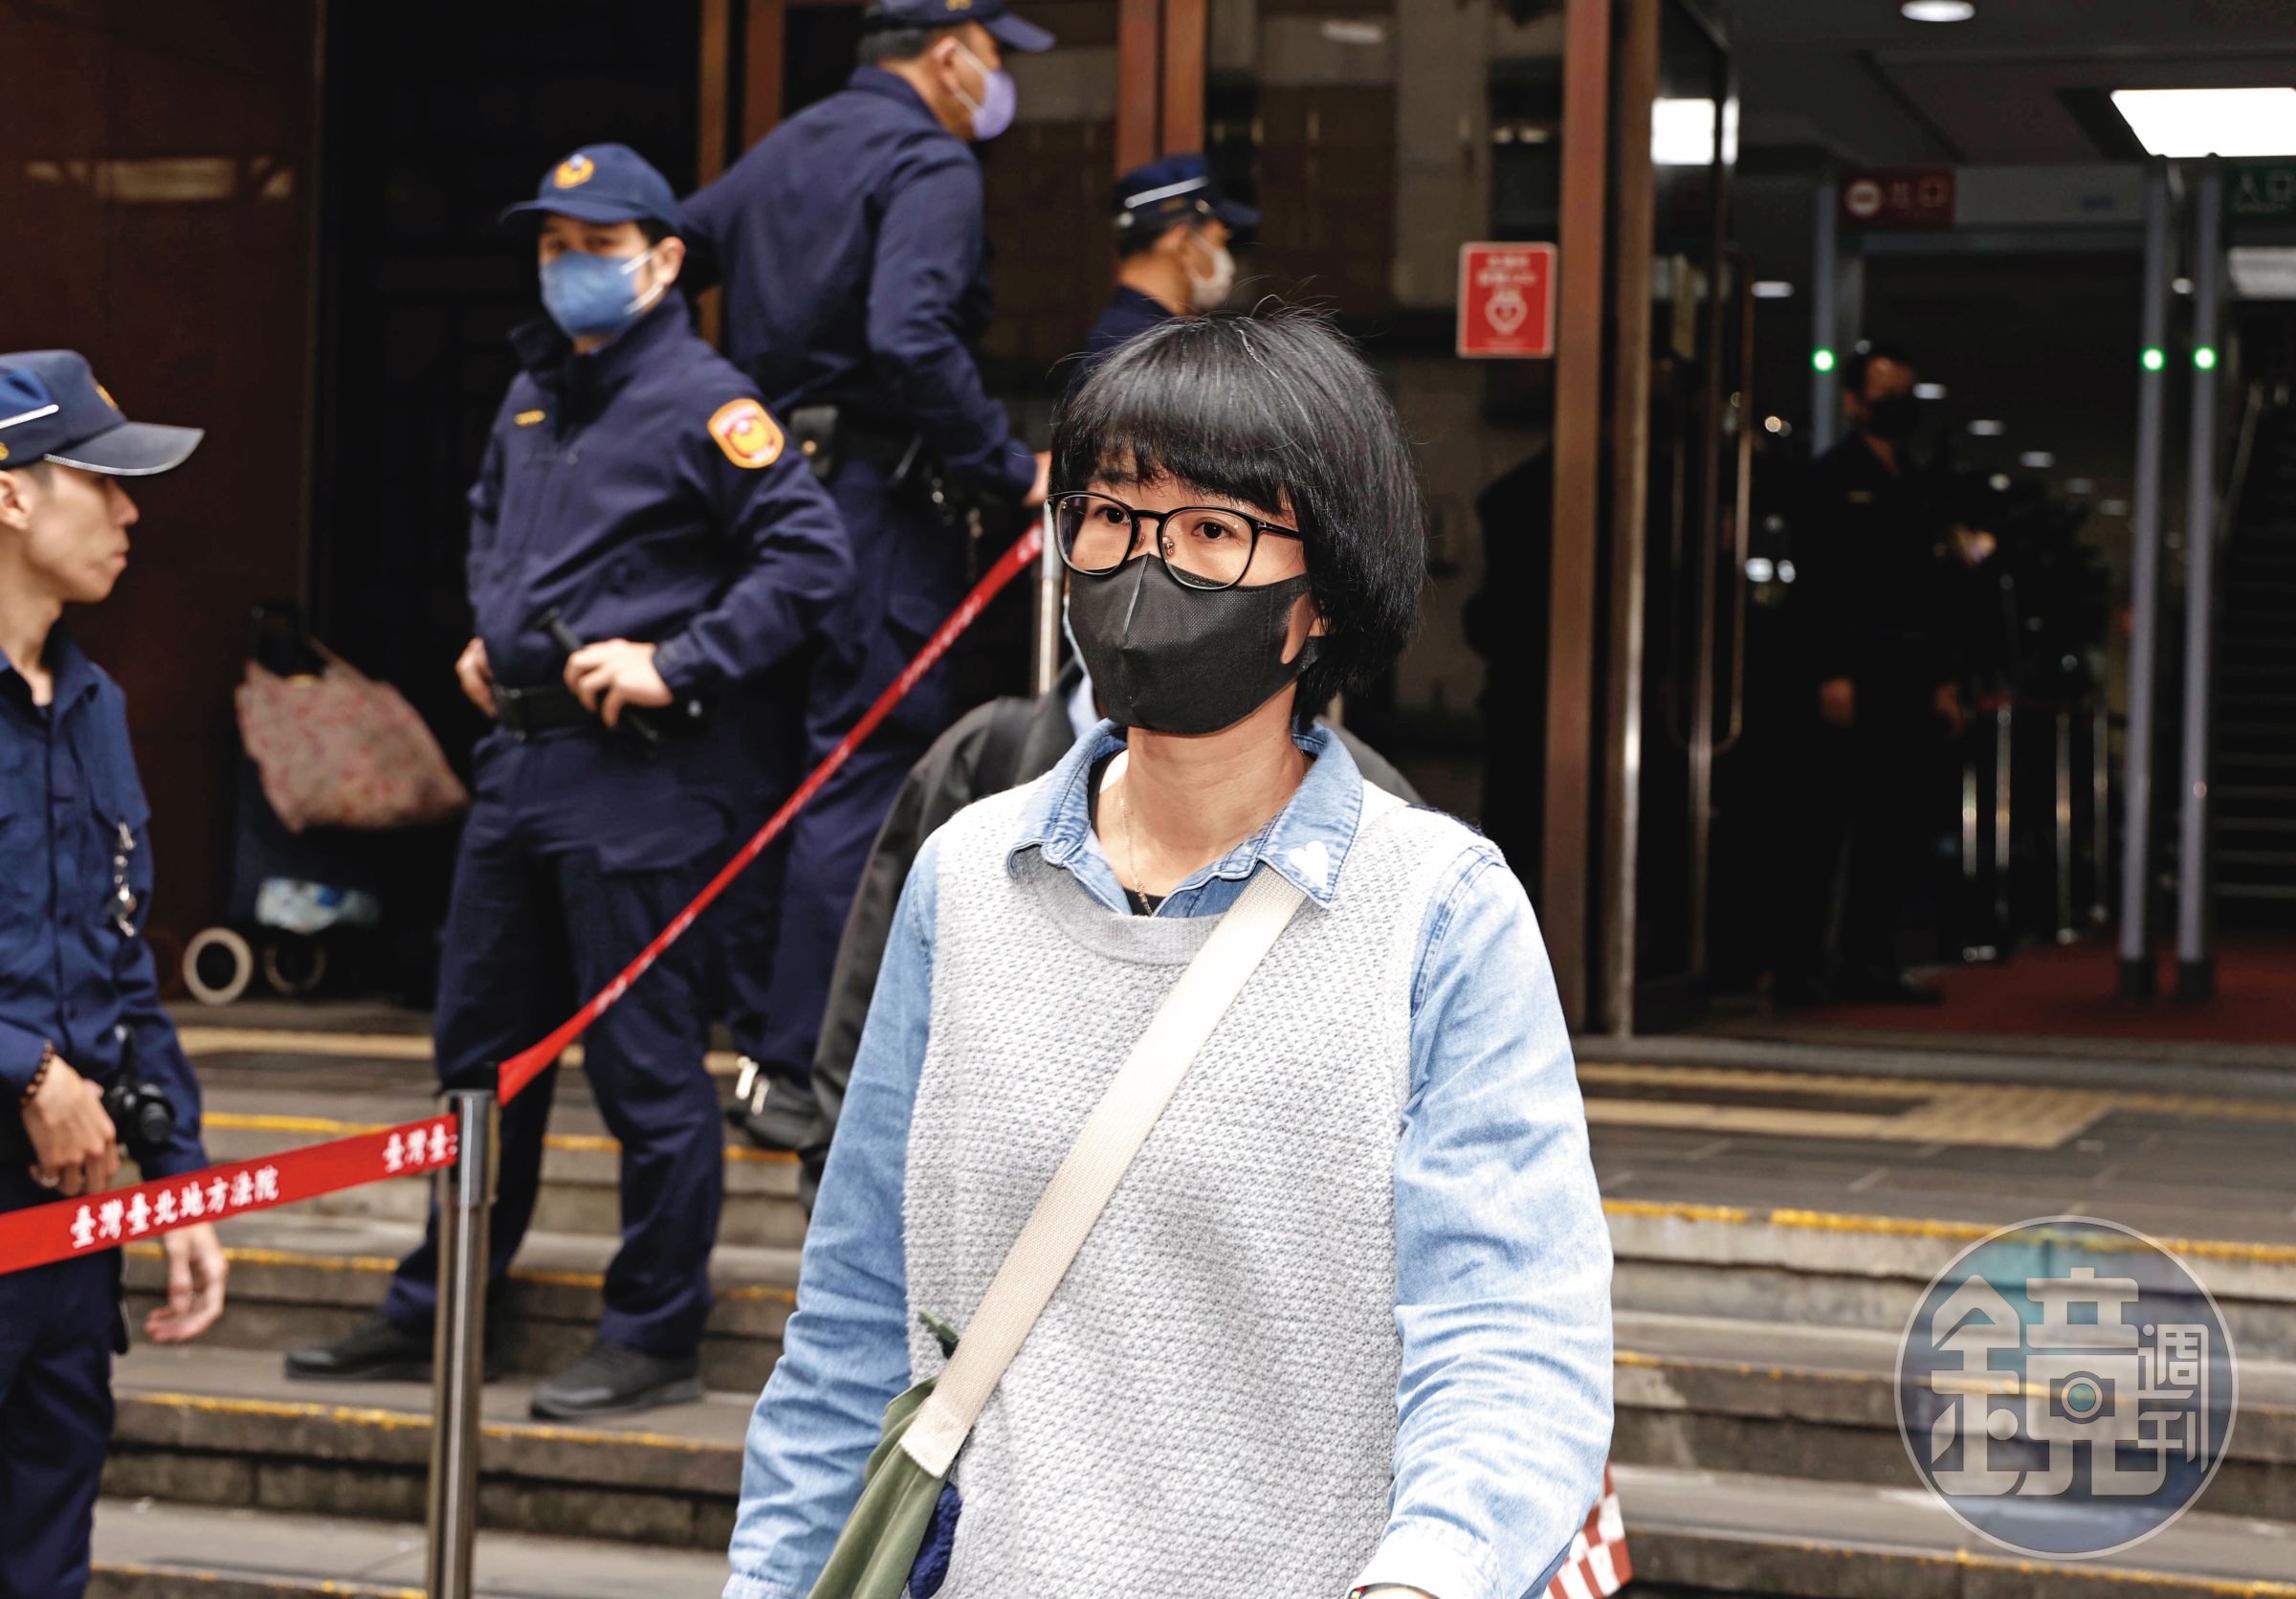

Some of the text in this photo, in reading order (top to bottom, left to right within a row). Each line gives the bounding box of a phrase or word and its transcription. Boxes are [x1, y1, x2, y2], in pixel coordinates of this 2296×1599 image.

[383, 1123, 457, 1173] 臺灣臺
[70, 1165, 279, 1249] 臺灣臺北地方法院
